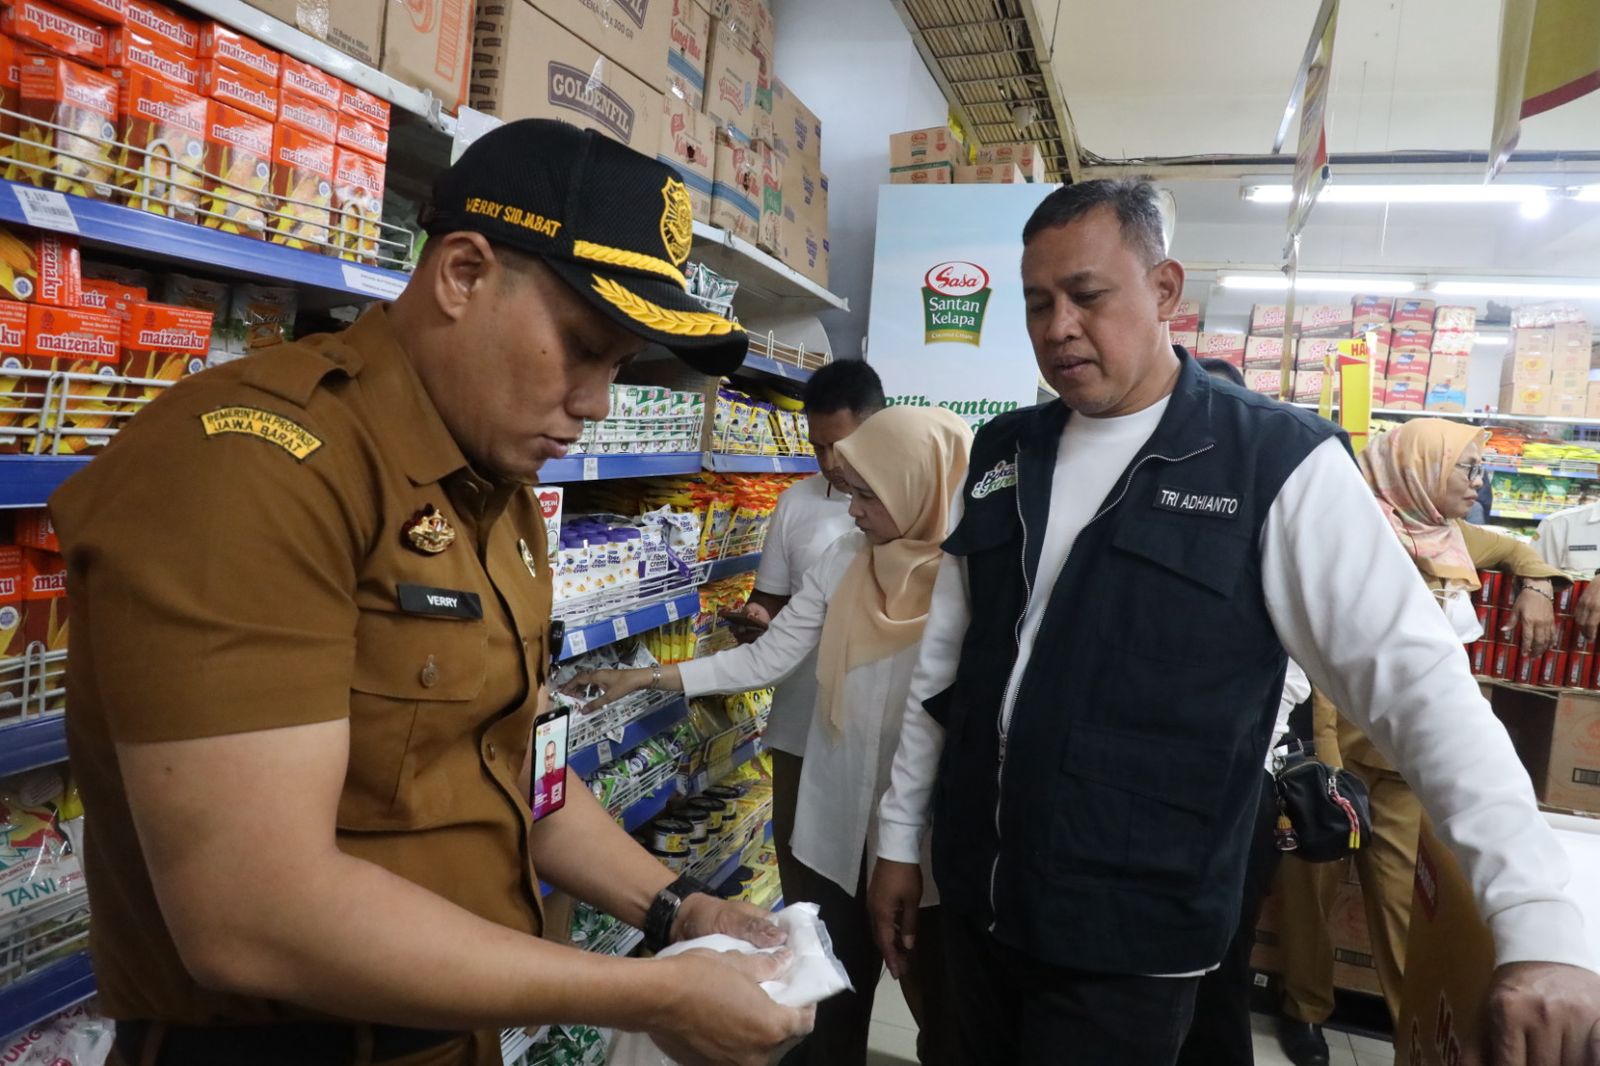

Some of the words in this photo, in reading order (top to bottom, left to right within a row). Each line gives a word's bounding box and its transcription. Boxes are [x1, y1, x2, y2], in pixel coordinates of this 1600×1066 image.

[127, 4, 195, 48] maizenaku
[128, 45, 196, 86] maizenaku
[218, 39, 279, 72] maizenaku
[217, 77, 276, 114] maizenaku
[552, 74, 630, 134] GOLDENFIL
[466, 198, 503, 218] VERRY
[42, 233, 63, 299] izenaku
[936, 266, 978, 289] Sasa
[929, 296, 980, 313] Santan
[932, 312, 975, 328] Kelapa
[37, 331, 115, 357] maizenaku
[139, 329, 206, 350] maizenaku
[214, 419, 254, 432] JAWA
[260, 424, 303, 452] BARAT
[1161, 489, 1180, 507] TRI
[1180, 494, 1239, 514] ADHIANTO
[426, 595, 458, 608] VERRY
[1, 877, 57, 907] TANI
